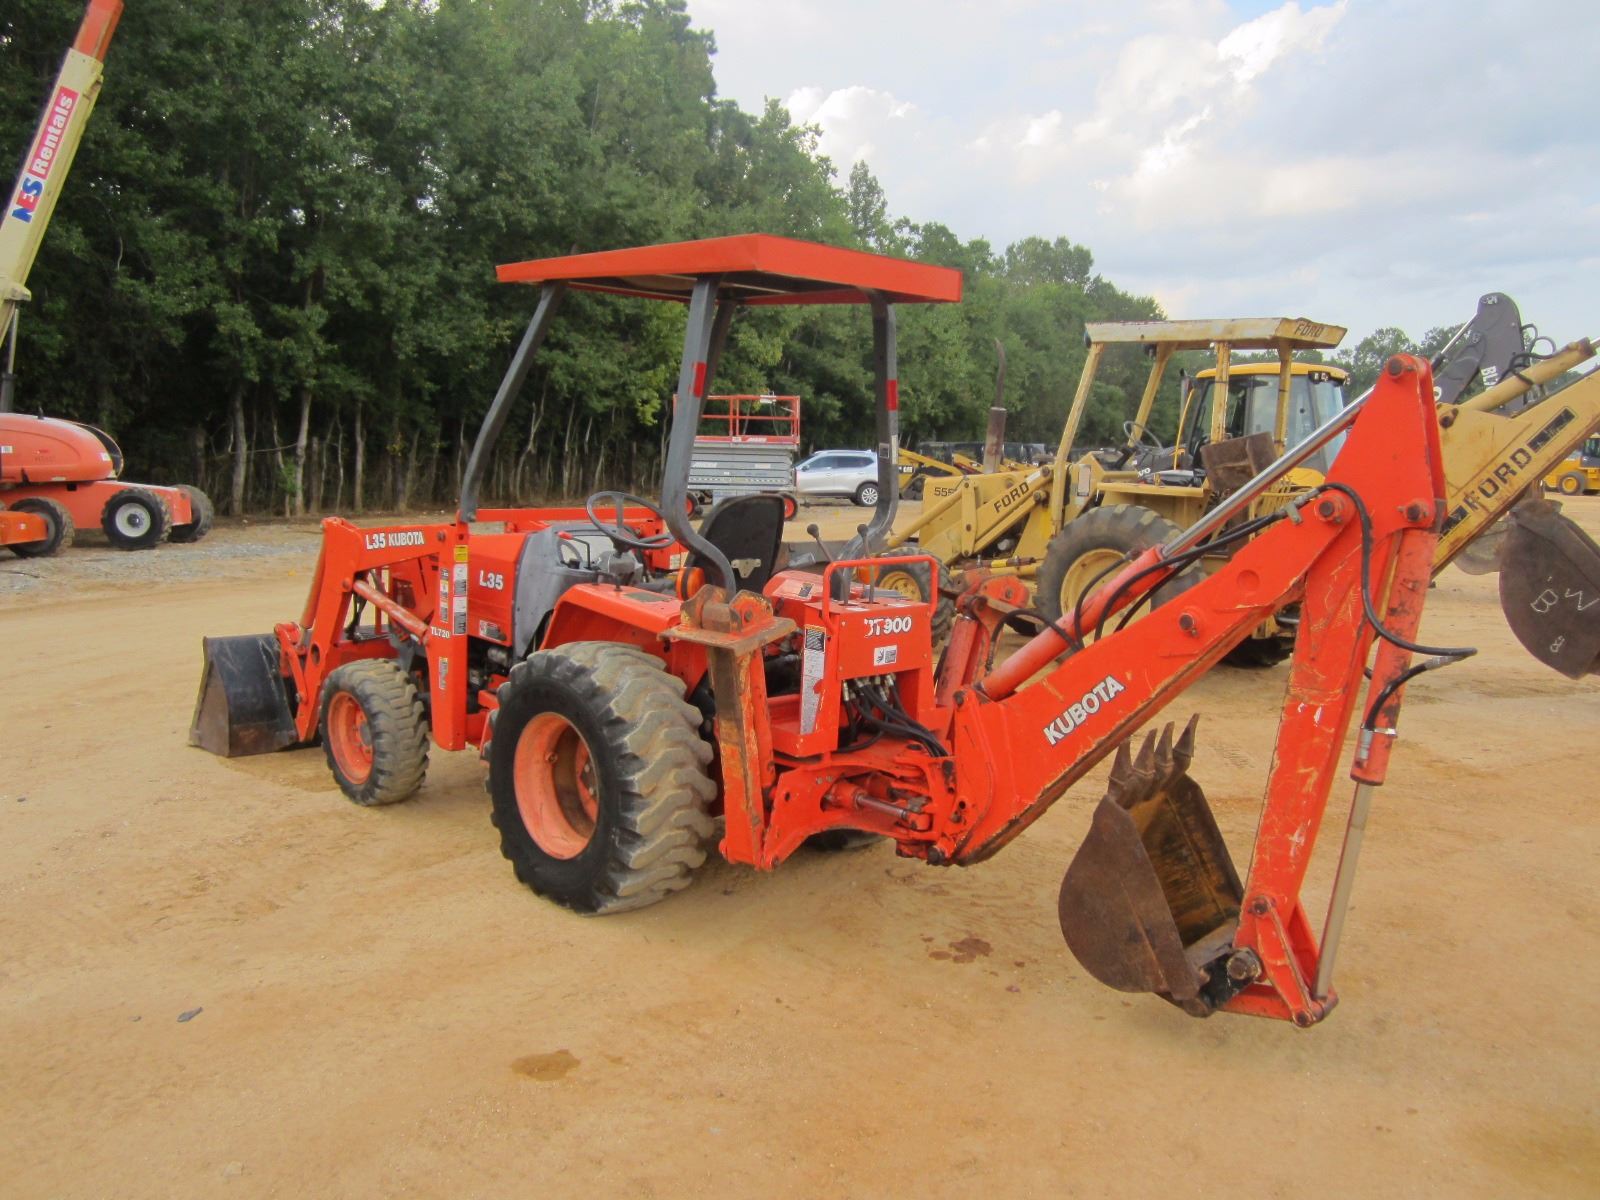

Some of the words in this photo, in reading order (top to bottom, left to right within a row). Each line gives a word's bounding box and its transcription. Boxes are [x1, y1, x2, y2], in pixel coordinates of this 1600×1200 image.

[12, 177, 43, 223] NES
[32, 93, 74, 175] Rentals
[1294, 322, 1324, 337] FORD
[1463, 447, 1532, 511] FORD
[993, 481, 1030, 513] FORD
[366, 532, 386, 550] L35
[388, 531, 425, 547] KUBOTA
[479, 570, 504, 590] L35
[430, 626, 450, 639] TL720
[1043, 675, 1125, 746] KUBOTA
